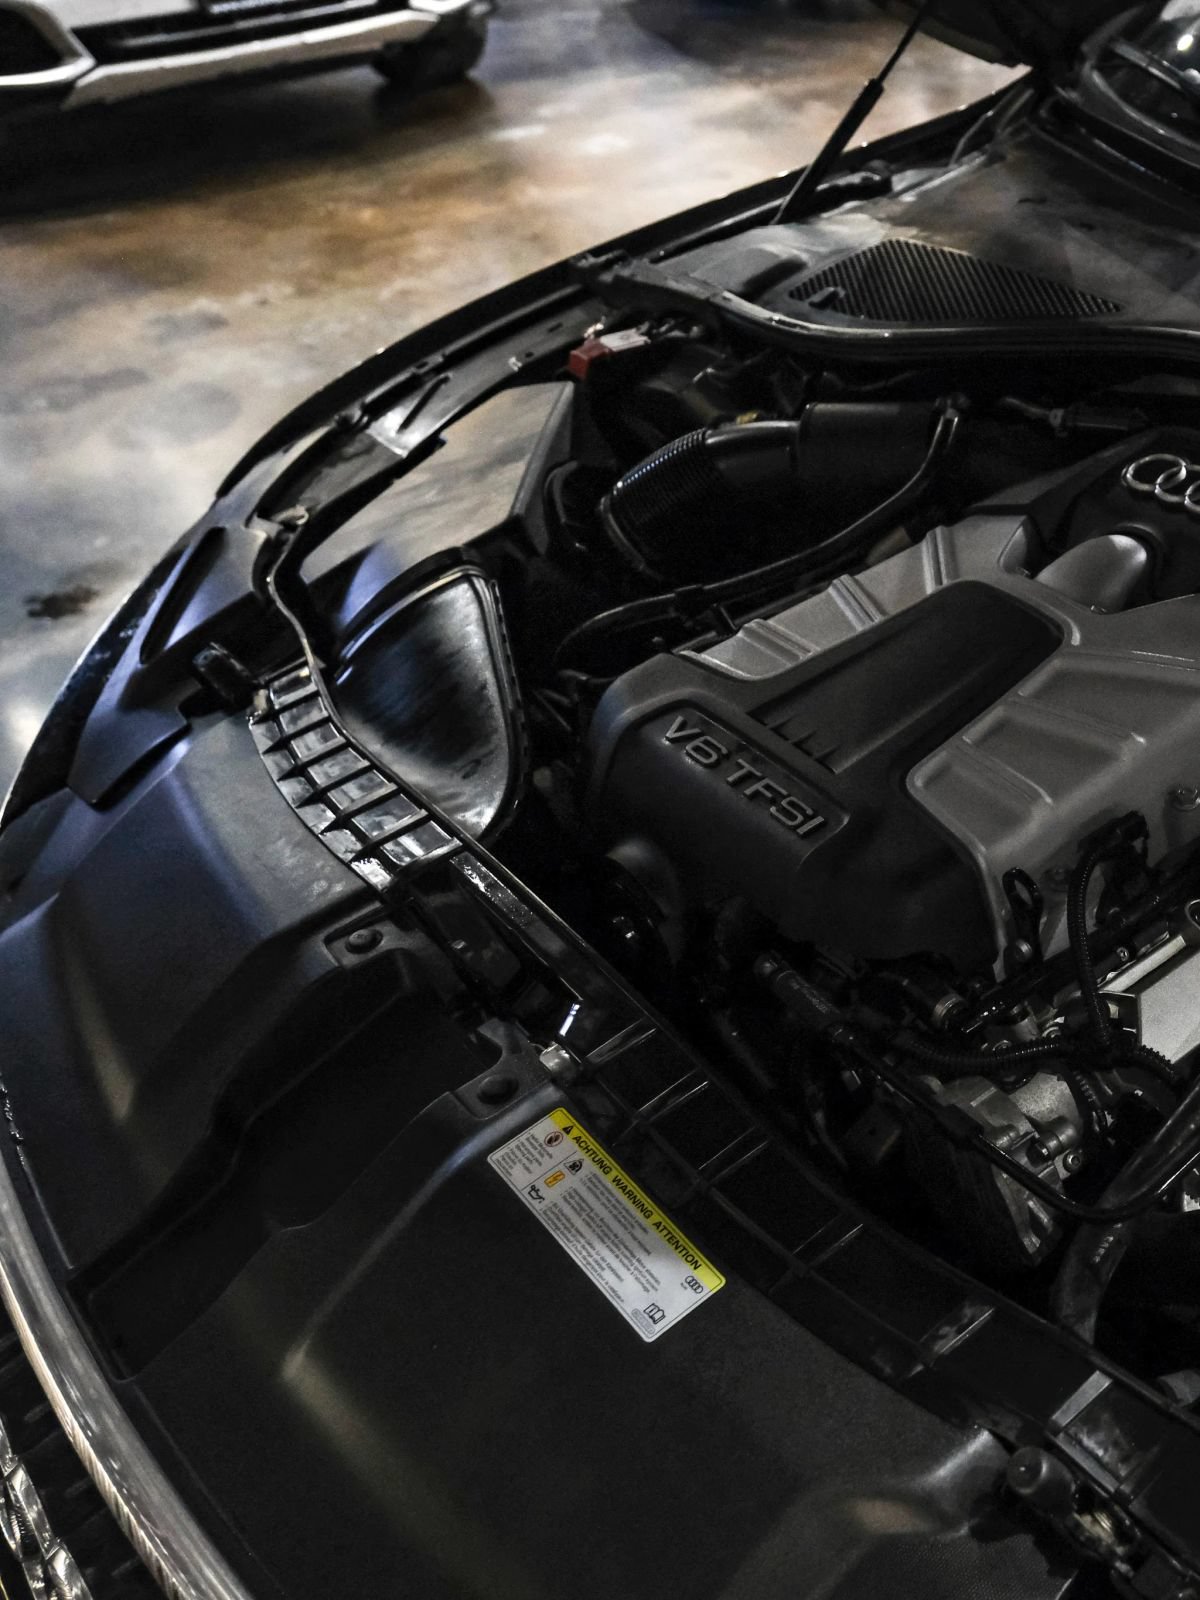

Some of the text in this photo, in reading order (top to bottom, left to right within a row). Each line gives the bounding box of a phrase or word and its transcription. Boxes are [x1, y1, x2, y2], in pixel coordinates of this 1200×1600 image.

[664, 715, 825, 836] V6 TFSI
[572, 1135, 612, 1176] ACHTUNG
[612, 1176, 652, 1219] WARNING
[653, 1220, 702, 1270] ATTENTION
